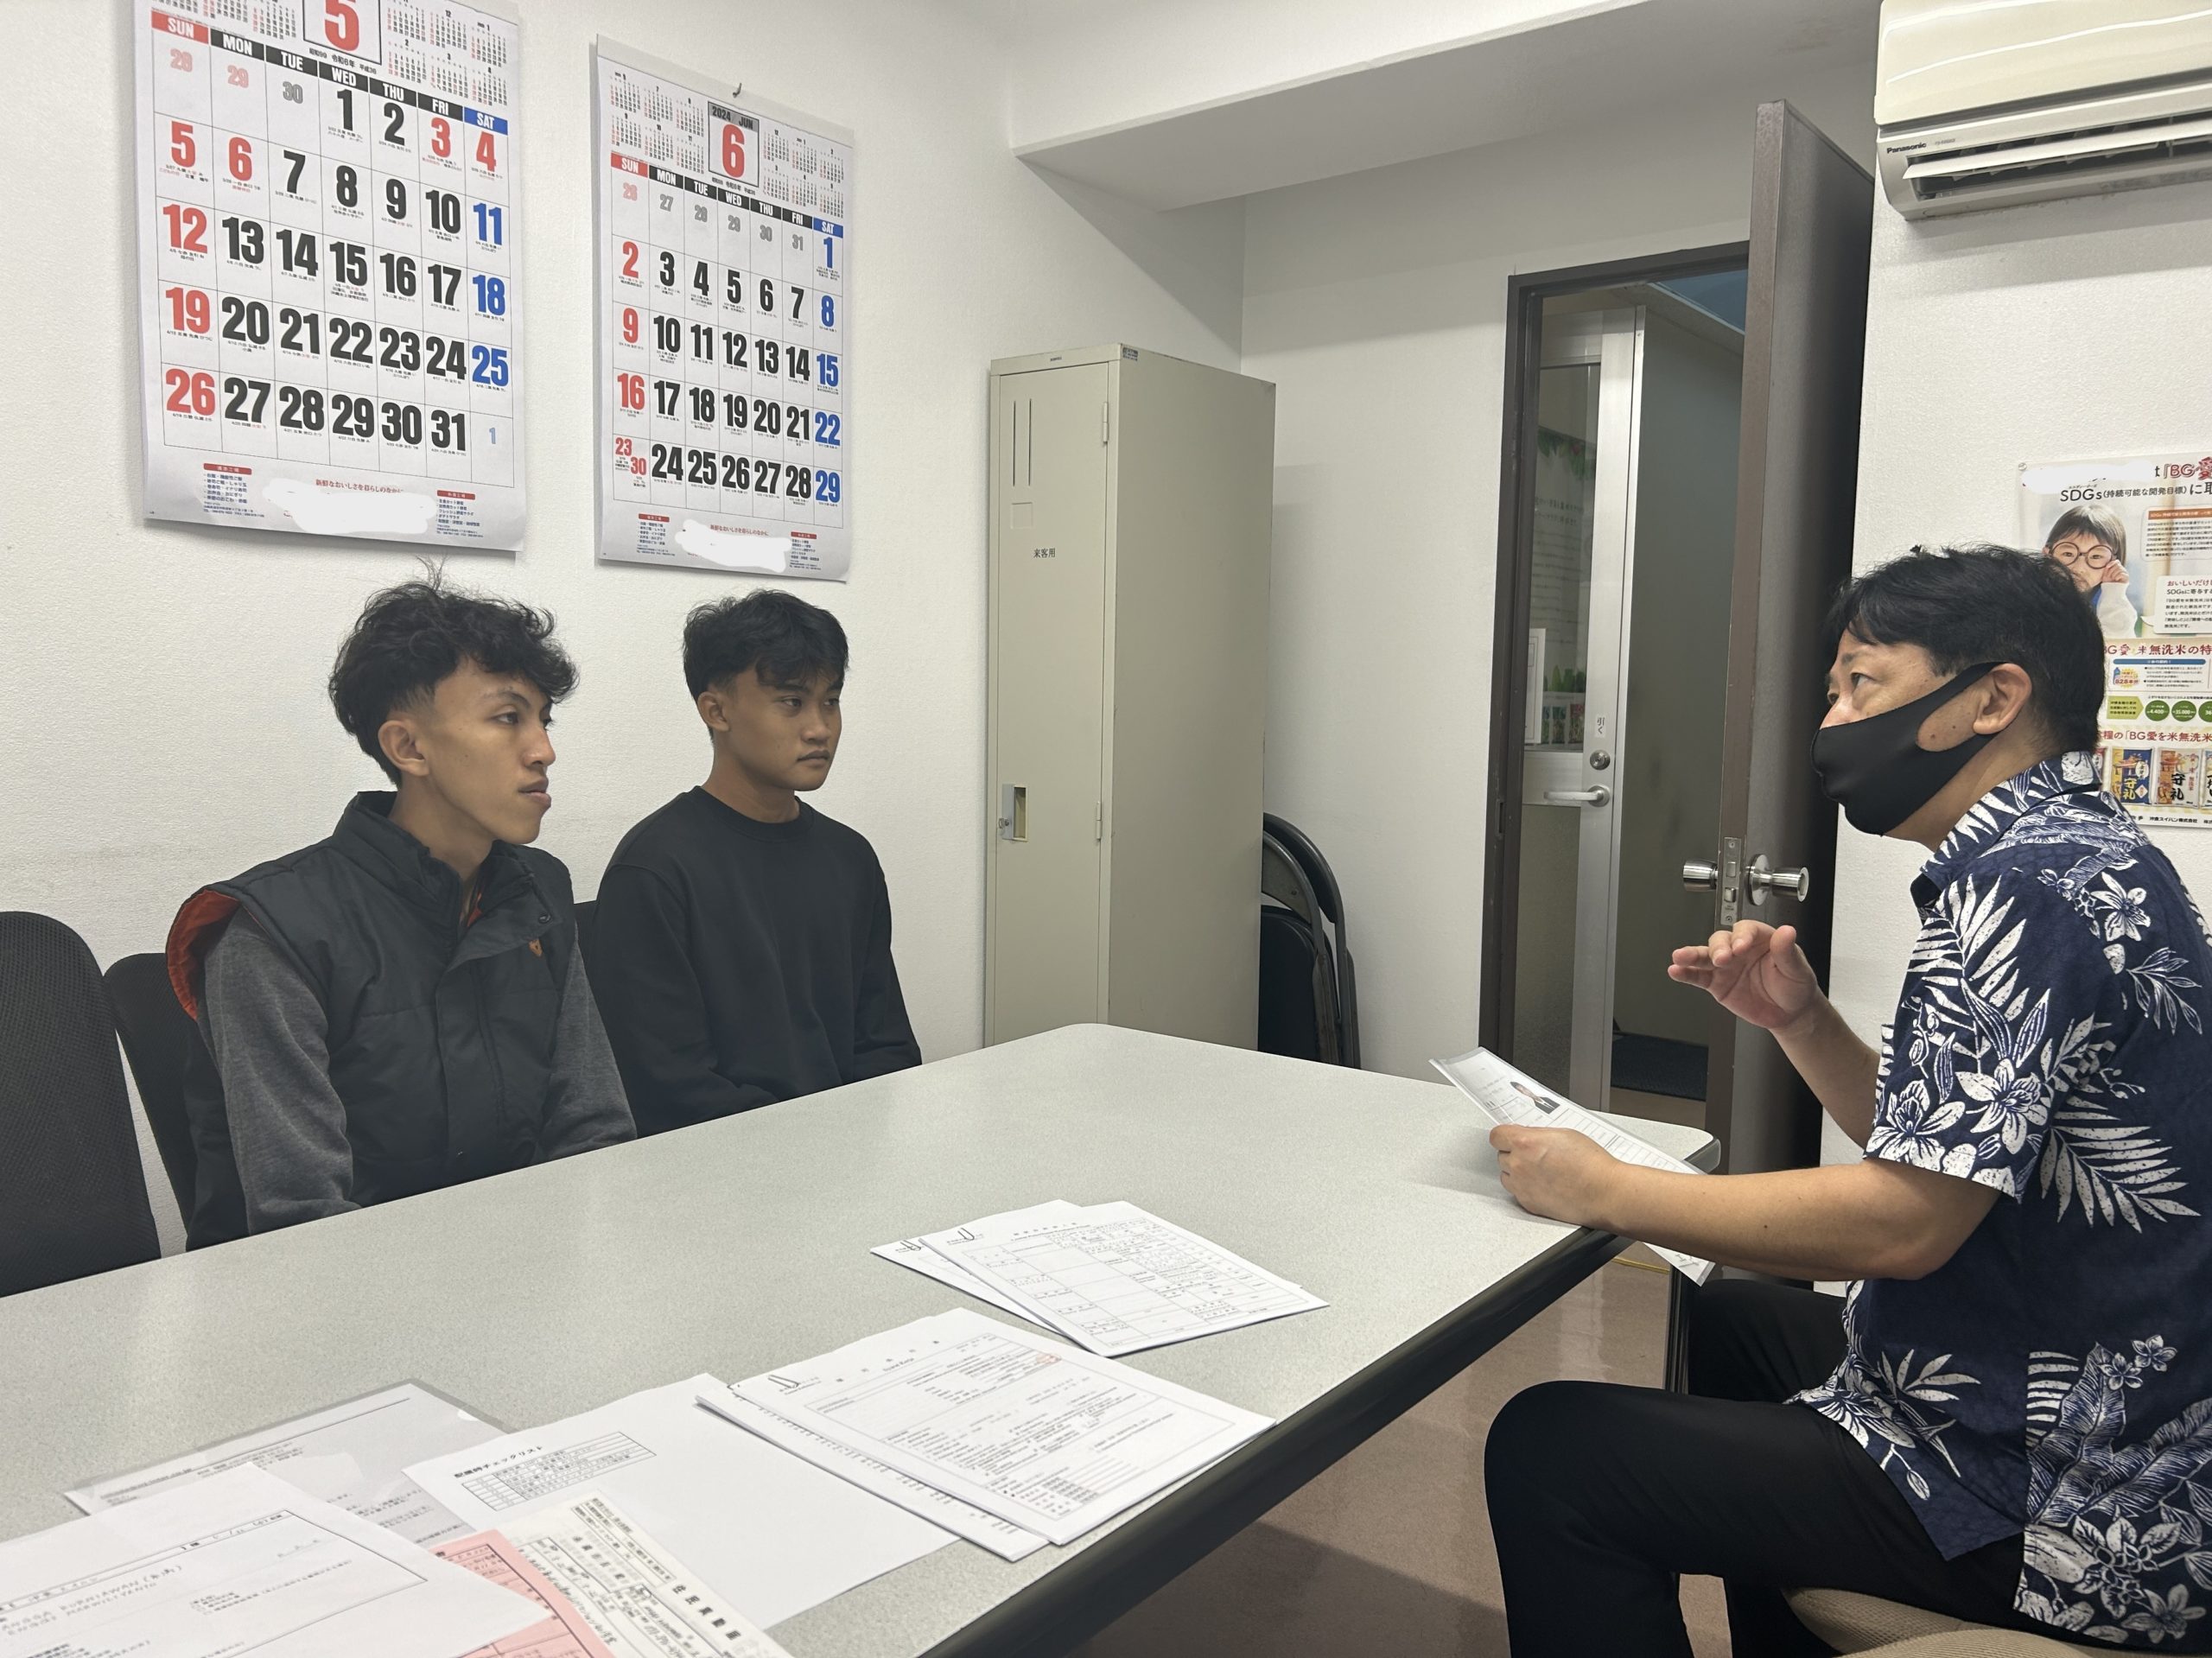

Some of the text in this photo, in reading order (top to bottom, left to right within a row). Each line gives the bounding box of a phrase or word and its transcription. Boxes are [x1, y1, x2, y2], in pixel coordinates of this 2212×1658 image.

[325, 0, 359, 51] 5
[168, 17, 194, 38] SUN
[223, 35, 252, 55] MON
[281, 51, 303, 69] TUE
[332, 67, 356, 86] WED
[384, 83, 404, 100] THU
[432, 98, 449, 116] FRI
[477, 111, 494, 129] SAT
[337, 89, 353, 130] 1
[385, 103, 404, 146] 2
[431, 118, 450, 157] 3
[476, 131, 496, 172] 4
[712, 105, 753, 130] 2024 JUN
[721, 124, 745, 179] 6
[1886, 142, 1927, 154] Panasonic
[172, 121, 502, 245] 5 6 7 8 9 10 11
[622, 157, 835, 234] SUN MON TUE WED THU FRI SAT
[163, 204, 505, 315] 12 13 14 15 16 17 18
[623, 242, 834, 327] 2 3 4 5 6 7 8
[823, 237, 832, 269] 1
[166, 287, 508, 386] 19 20 21 22 23 24 25
[623, 308, 838, 386] 9 10 11 12 13 14 15
[166, 369, 215, 416] 26
[225, 378, 270, 423] 27
[279, 386, 324, 430] 28
[332, 394, 374, 437] 29
[382, 403, 422, 445] 30
[431, 410, 466, 451] 31
[618, 373, 840, 446] 16 17 18 19 20 21 22
[616, 437, 840, 503] 23 24 25 26 27 28 29
[631, 457, 646, 475] 30
[1033, 548, 1056, 559] 来客用
[1597, 717, 1605, 734] 引く
[2171, 772, 2186, 801] 守礼
